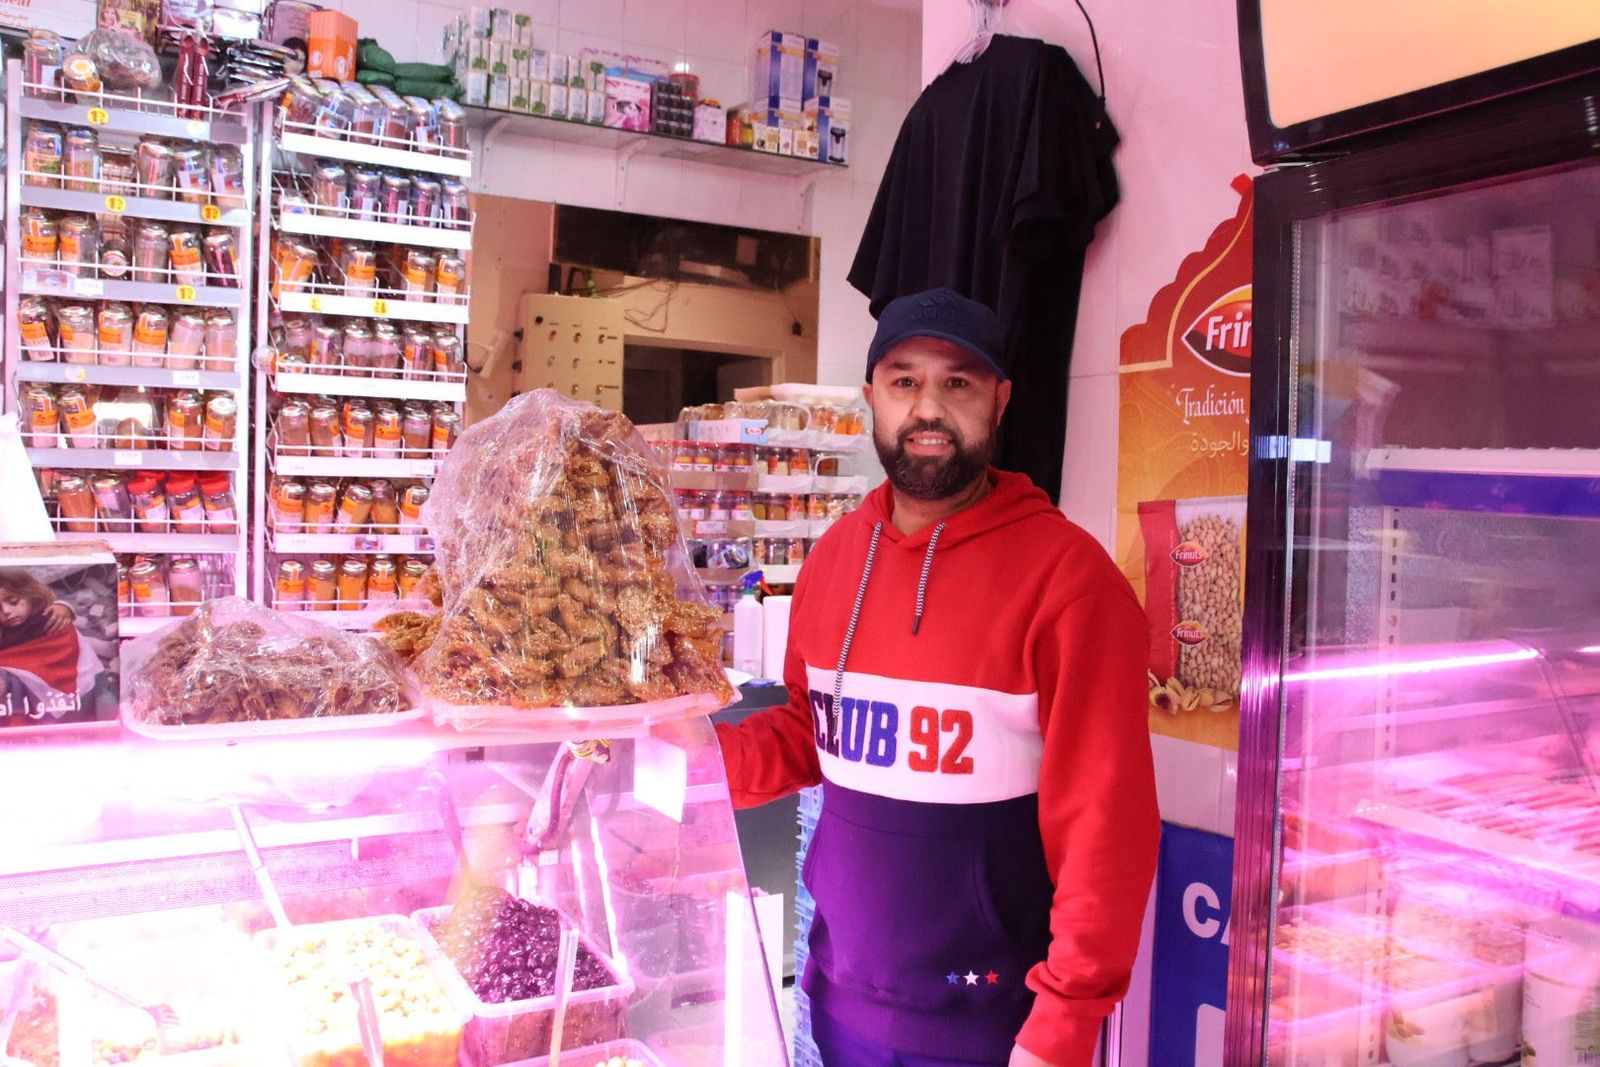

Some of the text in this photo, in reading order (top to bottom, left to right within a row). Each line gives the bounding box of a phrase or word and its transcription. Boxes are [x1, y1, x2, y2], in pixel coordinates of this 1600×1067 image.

[1176, 384, 1245, 425] Tradición
[1191, 431, 1249, 458] والجودة
[809, 689, 975, 774] CLUB 92
